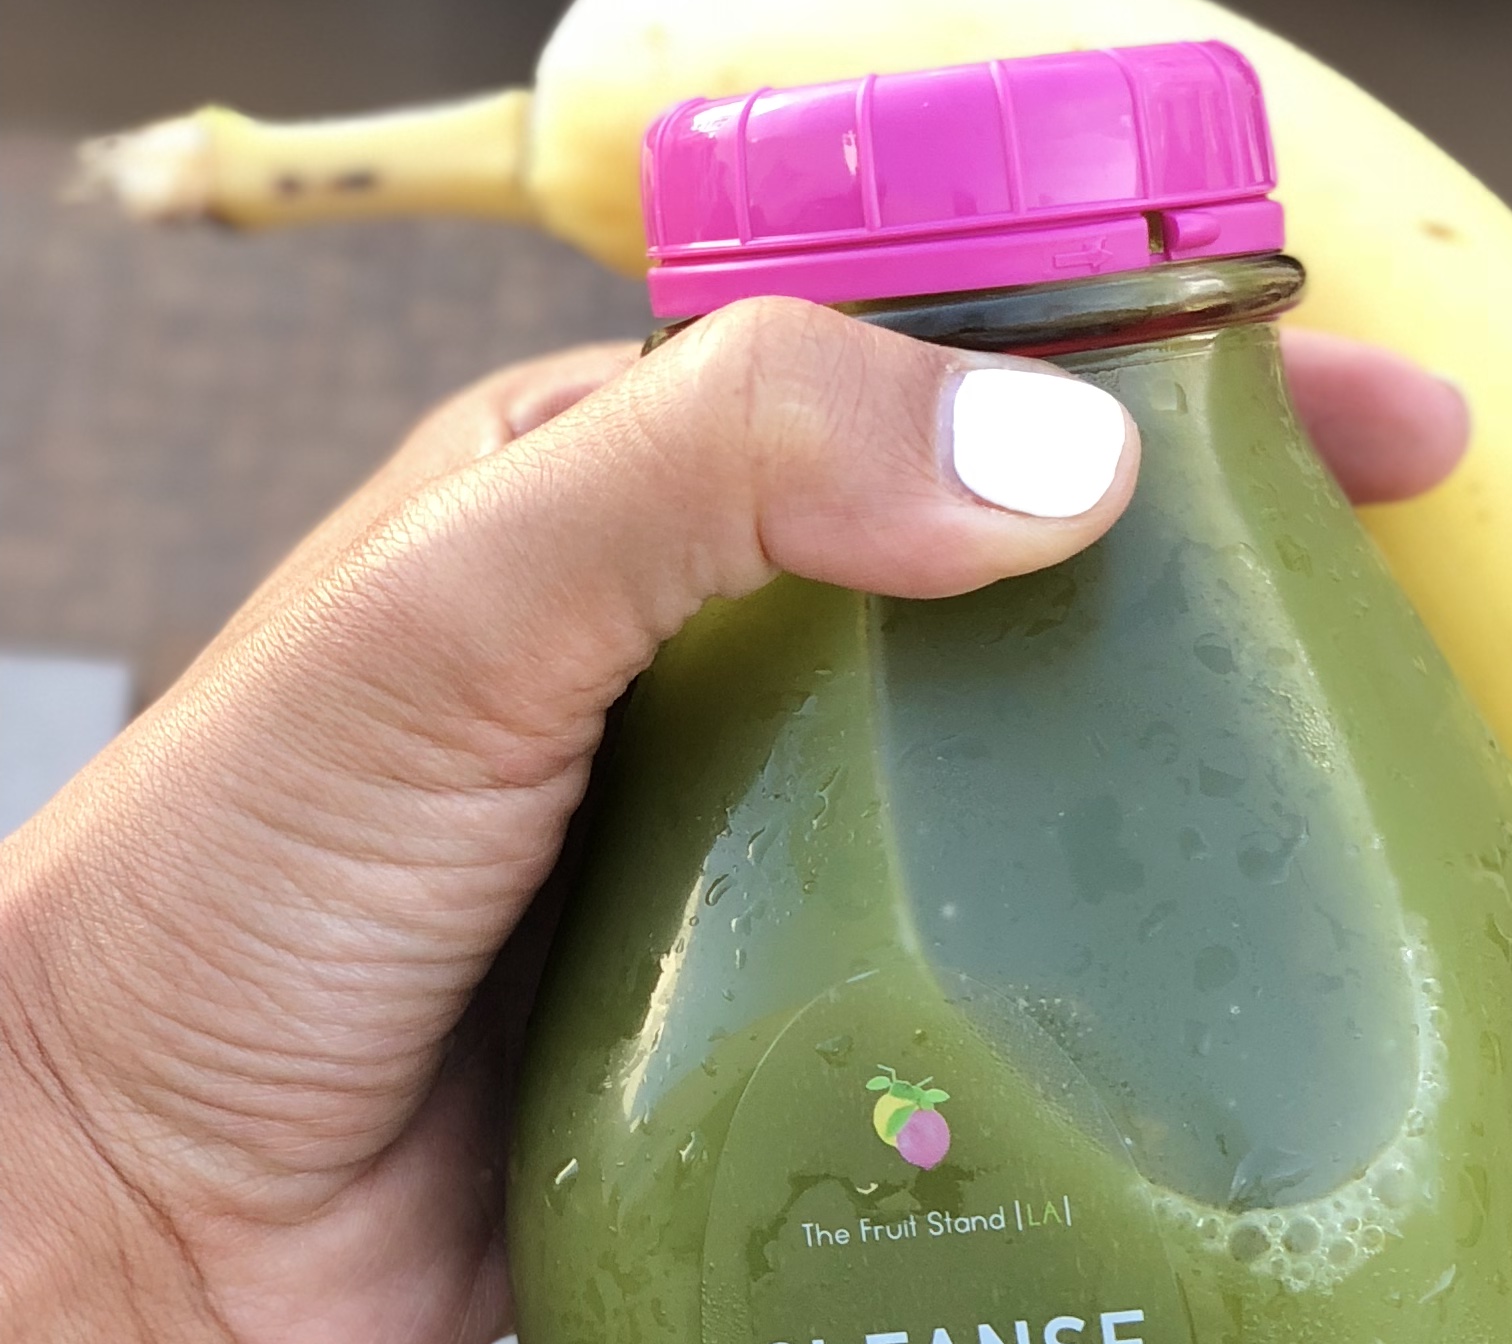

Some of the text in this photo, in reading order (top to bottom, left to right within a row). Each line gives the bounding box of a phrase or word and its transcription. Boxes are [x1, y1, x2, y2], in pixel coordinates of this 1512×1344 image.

[802, 1219, 850, 1247] The
[860, 1214, 917, 1243] Fruit
[927, 1207, 1005, 1236] Stand
